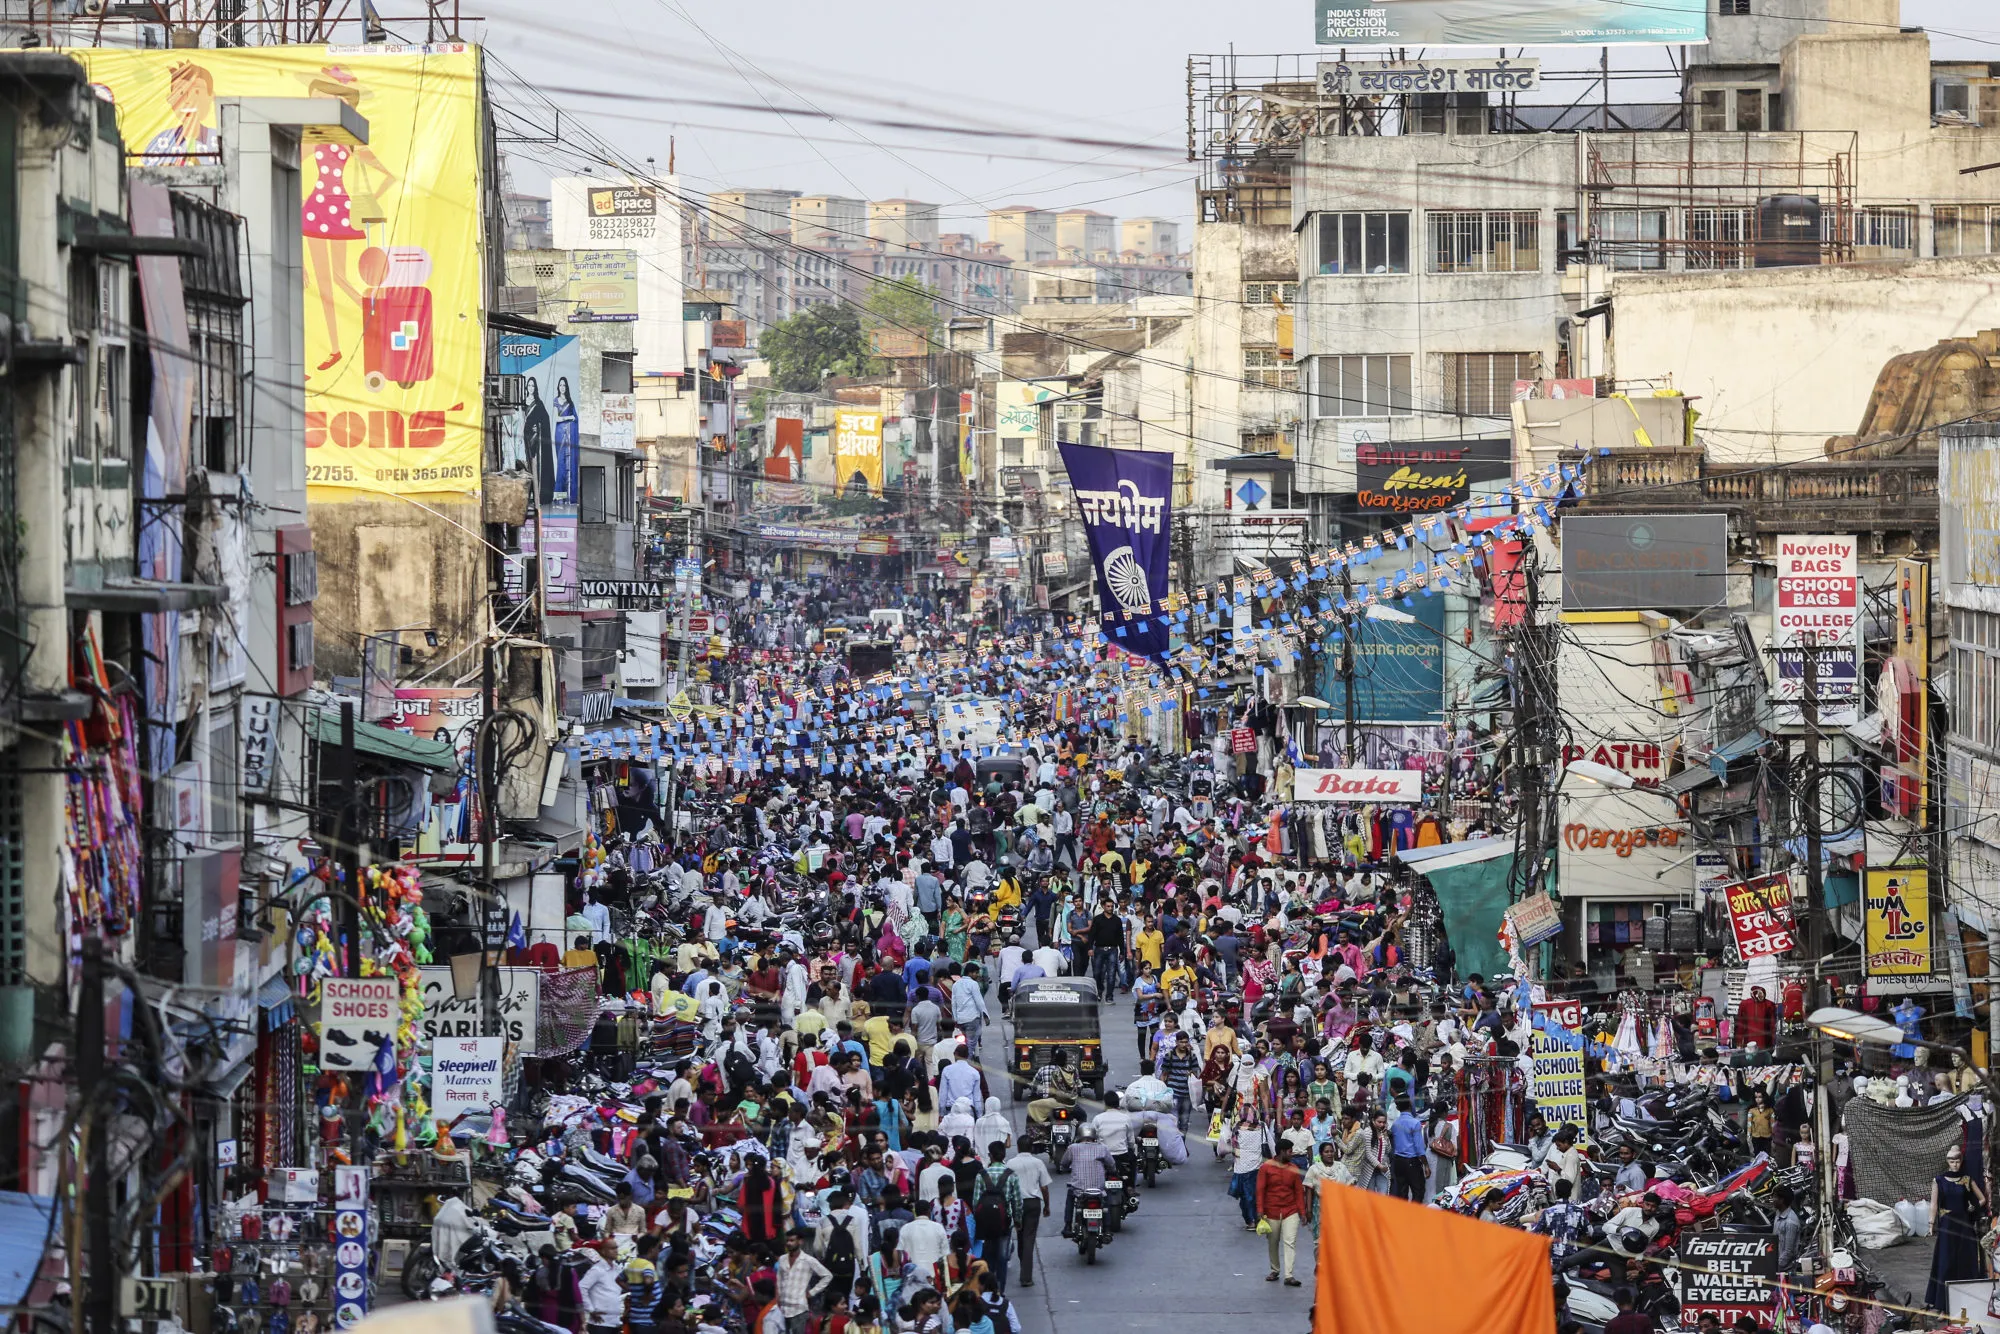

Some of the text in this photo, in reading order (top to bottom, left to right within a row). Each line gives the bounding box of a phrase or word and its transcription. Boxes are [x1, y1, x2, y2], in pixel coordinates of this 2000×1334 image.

[1327, 9, 1386, 18] INDIA'S FIRST
[1327, 18, 1386, 27] PRECISION
[1327, 27, 1386, 37] INVERTER
[1322, 60, 1535, 95] श्री व्यंकटेश मार्केट
[614, 190, 640, 200] grace
[596, 201, 611, 210] ad
[614, 199, 652, 213] space
[502, 343, 541, 357] उपलब्ध
[375, 468, 408, 481] OPEN
[412, 468, 437, 481] 365
[440, 465, 473, 479] DAYS
[1383, 466, 1467, 491] Men's
[1357, 490, 1452, 513] Manyavar
[1782, 542, 1851, 558] Novelty
[1791, 560, 1842, 573] BAGS
[581, 581, 660, 596] MONTINA
[1781, 578, 1853, 592] SCHOOL
[1793, 592, 1840, 606] BAGS
[1780, 614, 1854, 628] COLLEGE
[1396, 643, 1440, 657] ROOM
[1313, 773, 1401, 795] Bata
[1876, 976, 1907, 985] DRESS
[326, 983, 395, 999] SCHOOL
[332, 1003, 389, 1018] SHOES
[437, 1059, 497, 1074] Sleepwell
[1535, 1057, 1582, 1076] SCHOOL
[443, 1074, 492, 1085] Mattress
[445, 1089, 477, 1101] मिलता
[1537, 1080, 1583, 1098] COLLEGE
[1538, 1105, 1586, 1122] TRAVEL
[1686, 1237, 1766, 1257] fastrack
[1707, 1260, 1753, 1273] BELT
[1692, 1274, 1766, 1288] WALLET
[1687, 1289, 1772, 1302] EYEGEAR
